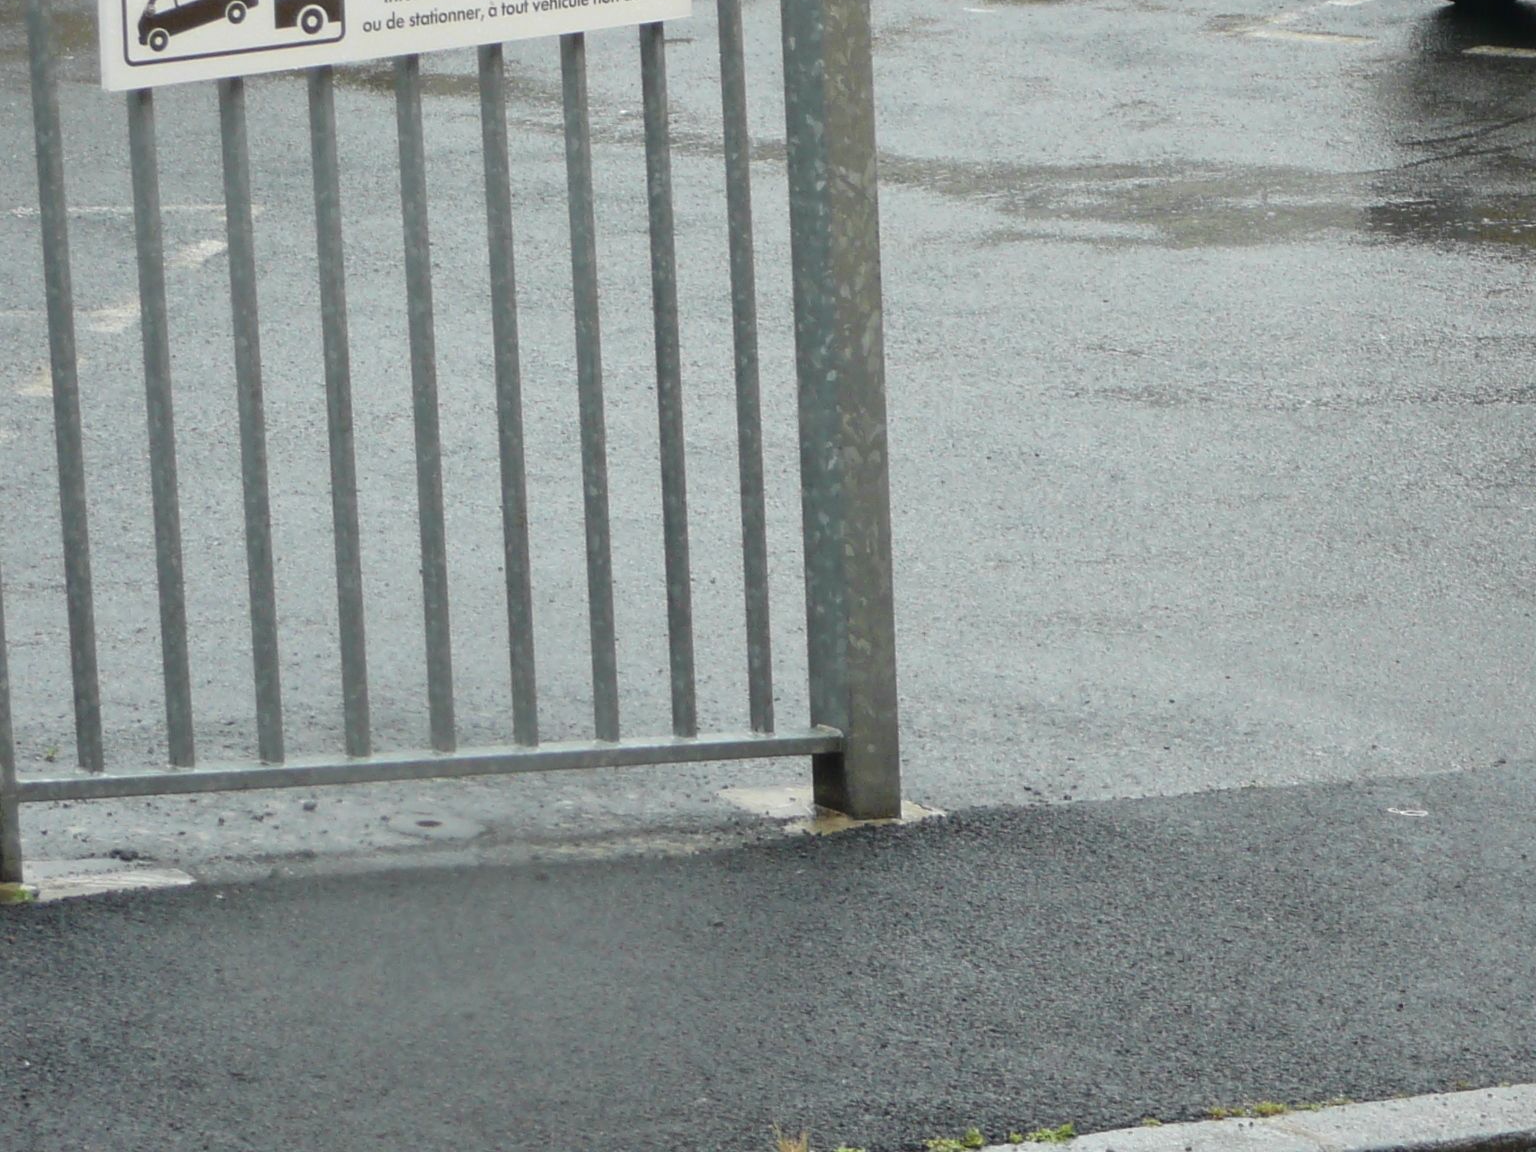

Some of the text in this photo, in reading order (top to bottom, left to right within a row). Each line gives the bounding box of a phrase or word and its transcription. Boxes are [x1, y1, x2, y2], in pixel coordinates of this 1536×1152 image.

[363, 20, 381, 33] ou
[386, 13, 404, 30] de
[409, 6, 485, 28] stationner,
[488, 0, 498, 18] à
